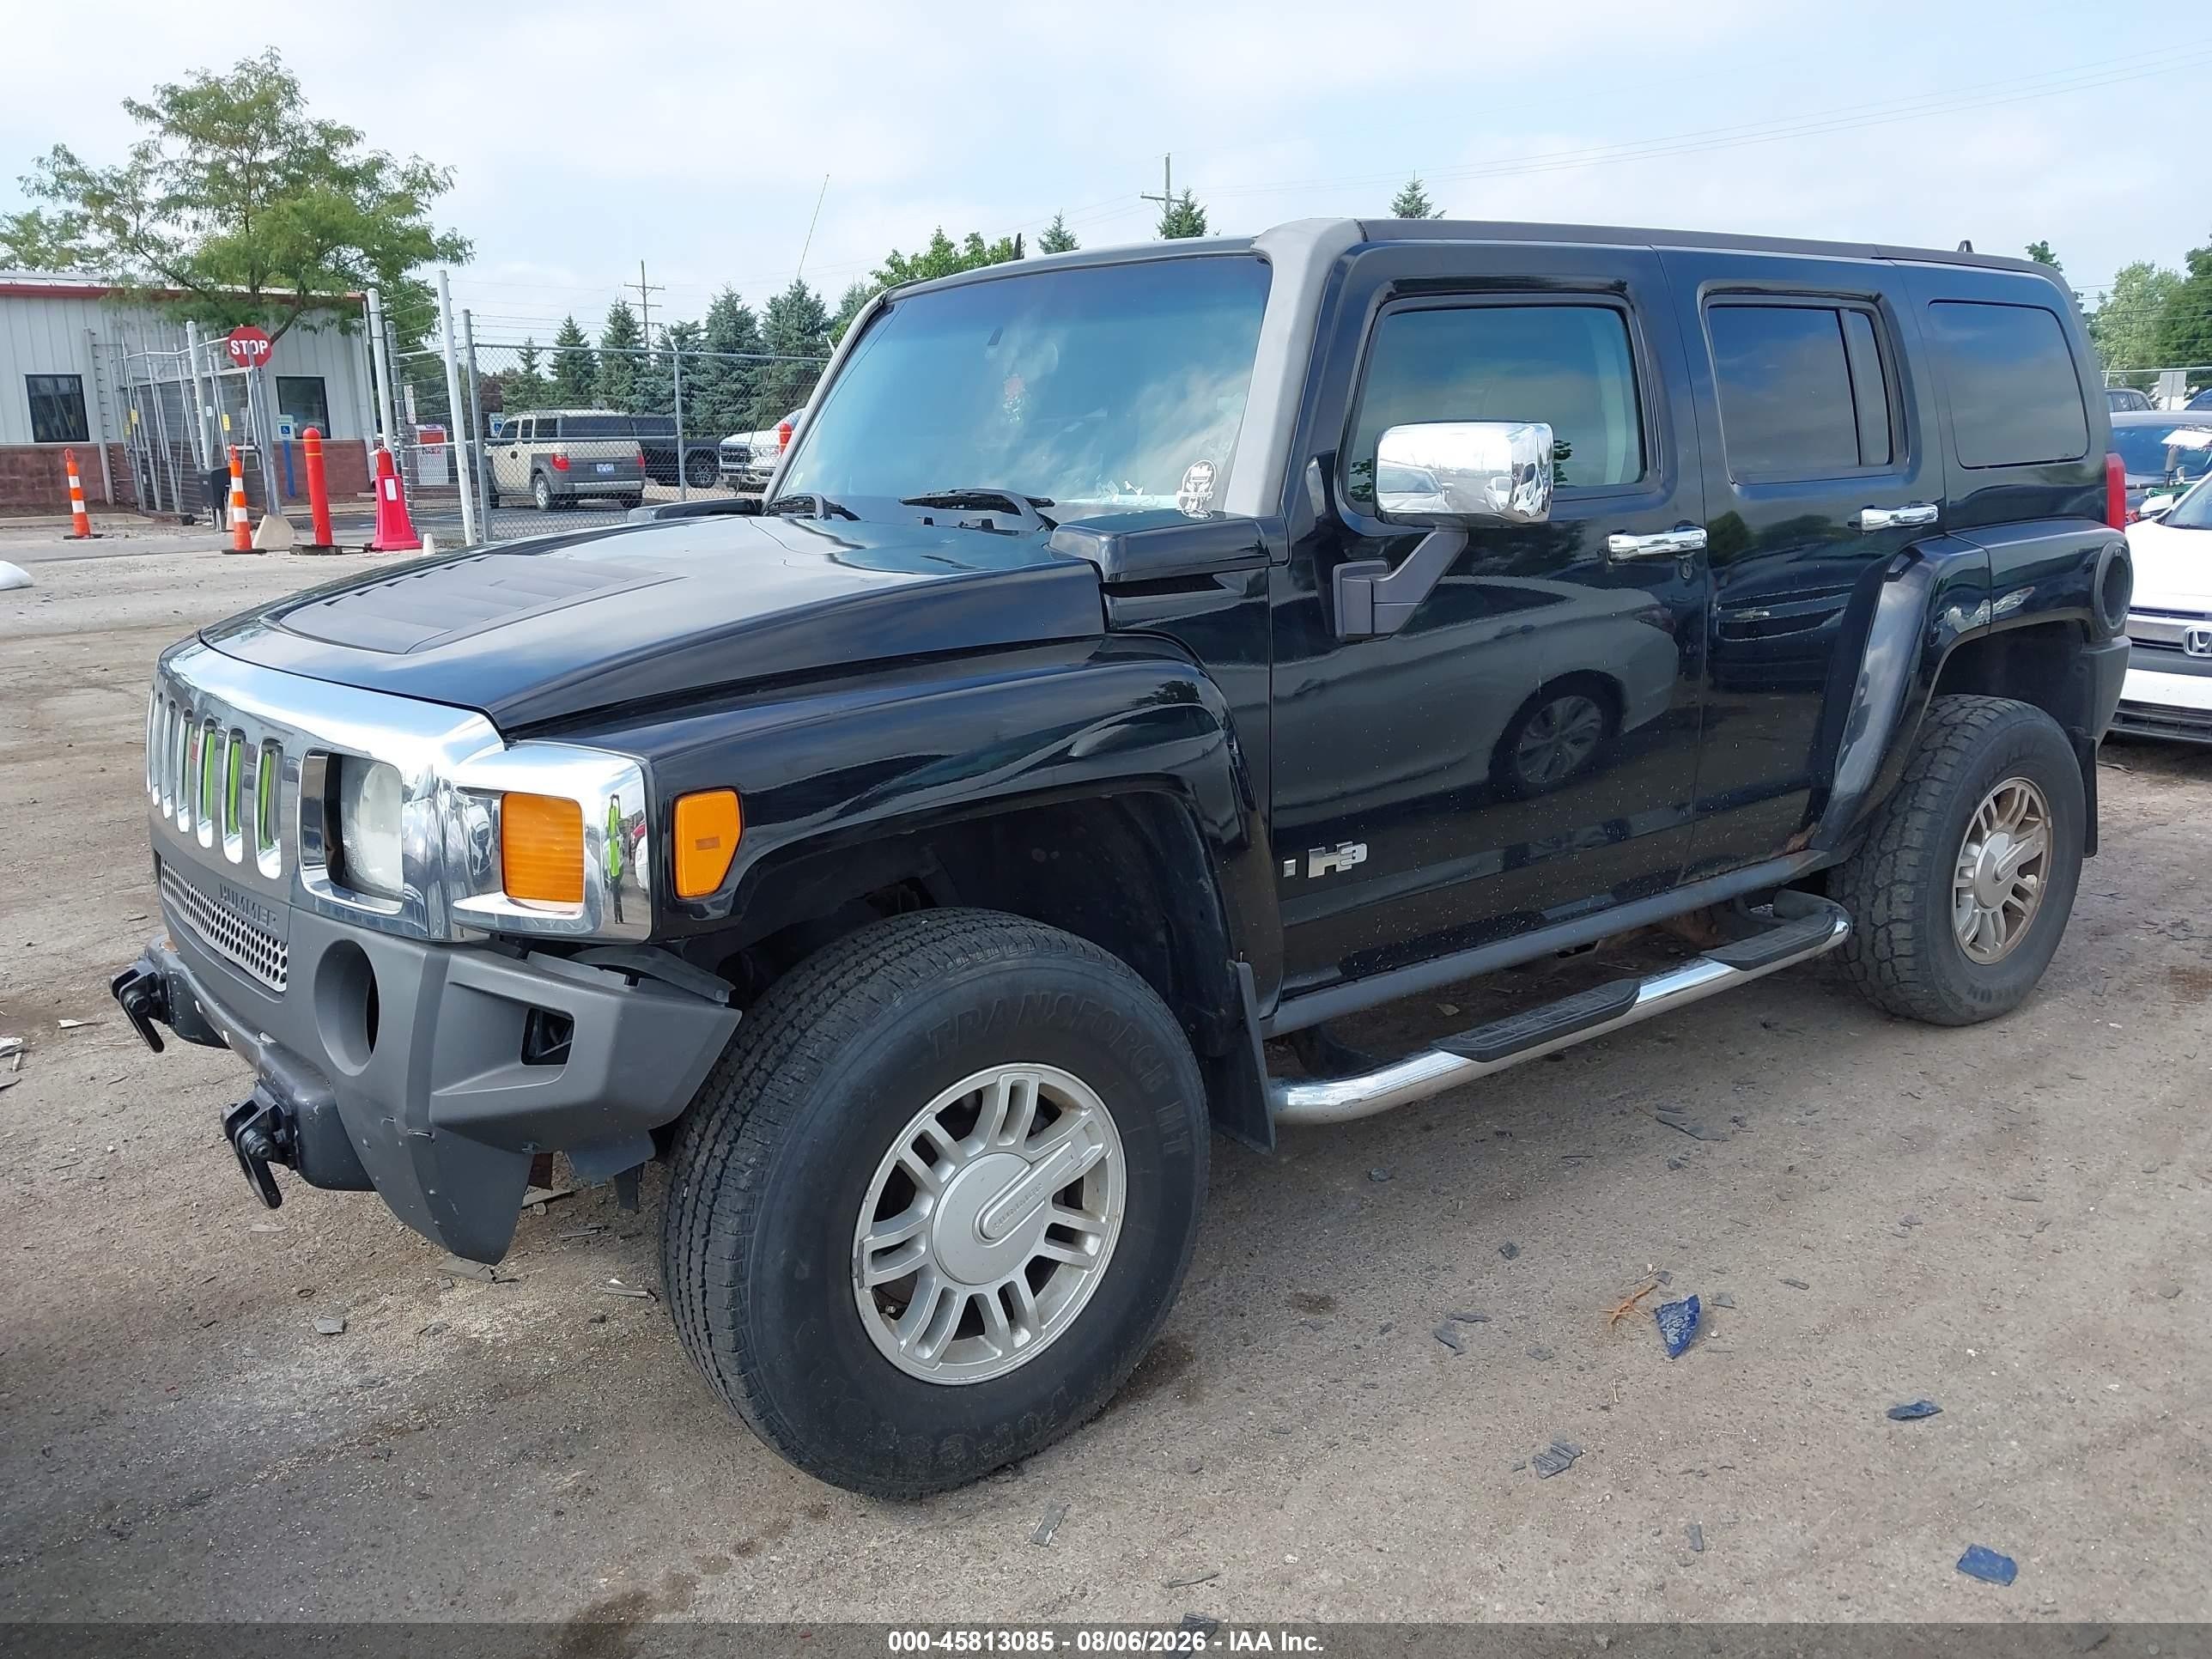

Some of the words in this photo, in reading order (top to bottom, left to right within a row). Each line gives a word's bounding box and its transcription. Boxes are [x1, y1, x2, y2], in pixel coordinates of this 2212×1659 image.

[230, 339, 269, 356] STOP
[1308, 841, 1368, 878] H3
[927, 991, 1170, 1093] TRANSFORCE
